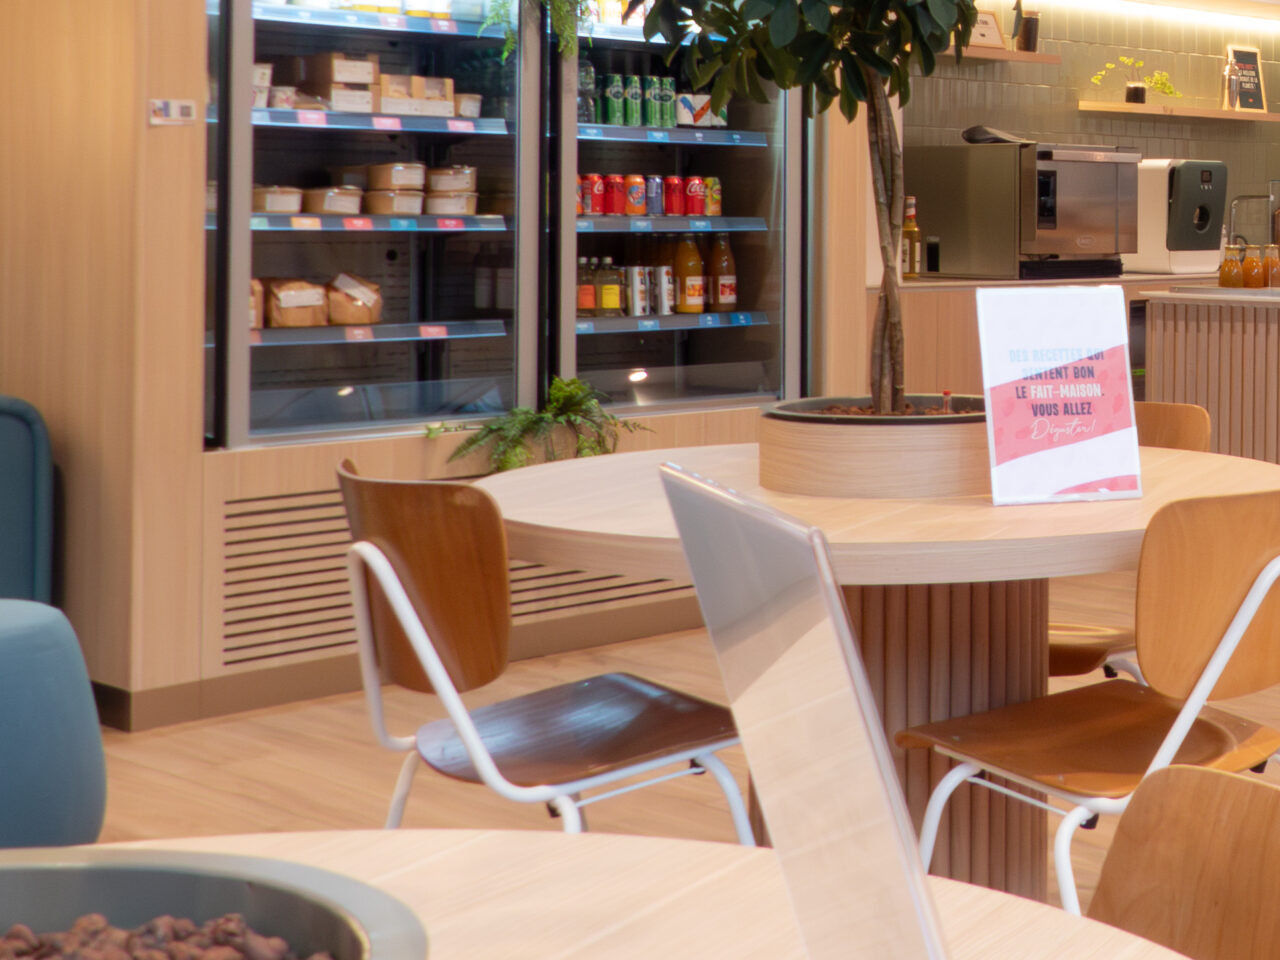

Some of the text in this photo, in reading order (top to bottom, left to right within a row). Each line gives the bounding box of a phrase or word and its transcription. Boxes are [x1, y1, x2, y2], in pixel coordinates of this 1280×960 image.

[1073, 365, 1095, 380] BON
[1015, 385, 1028, 399] LE
[1031, 401, 1093, 417] VOUS ALLEZ
